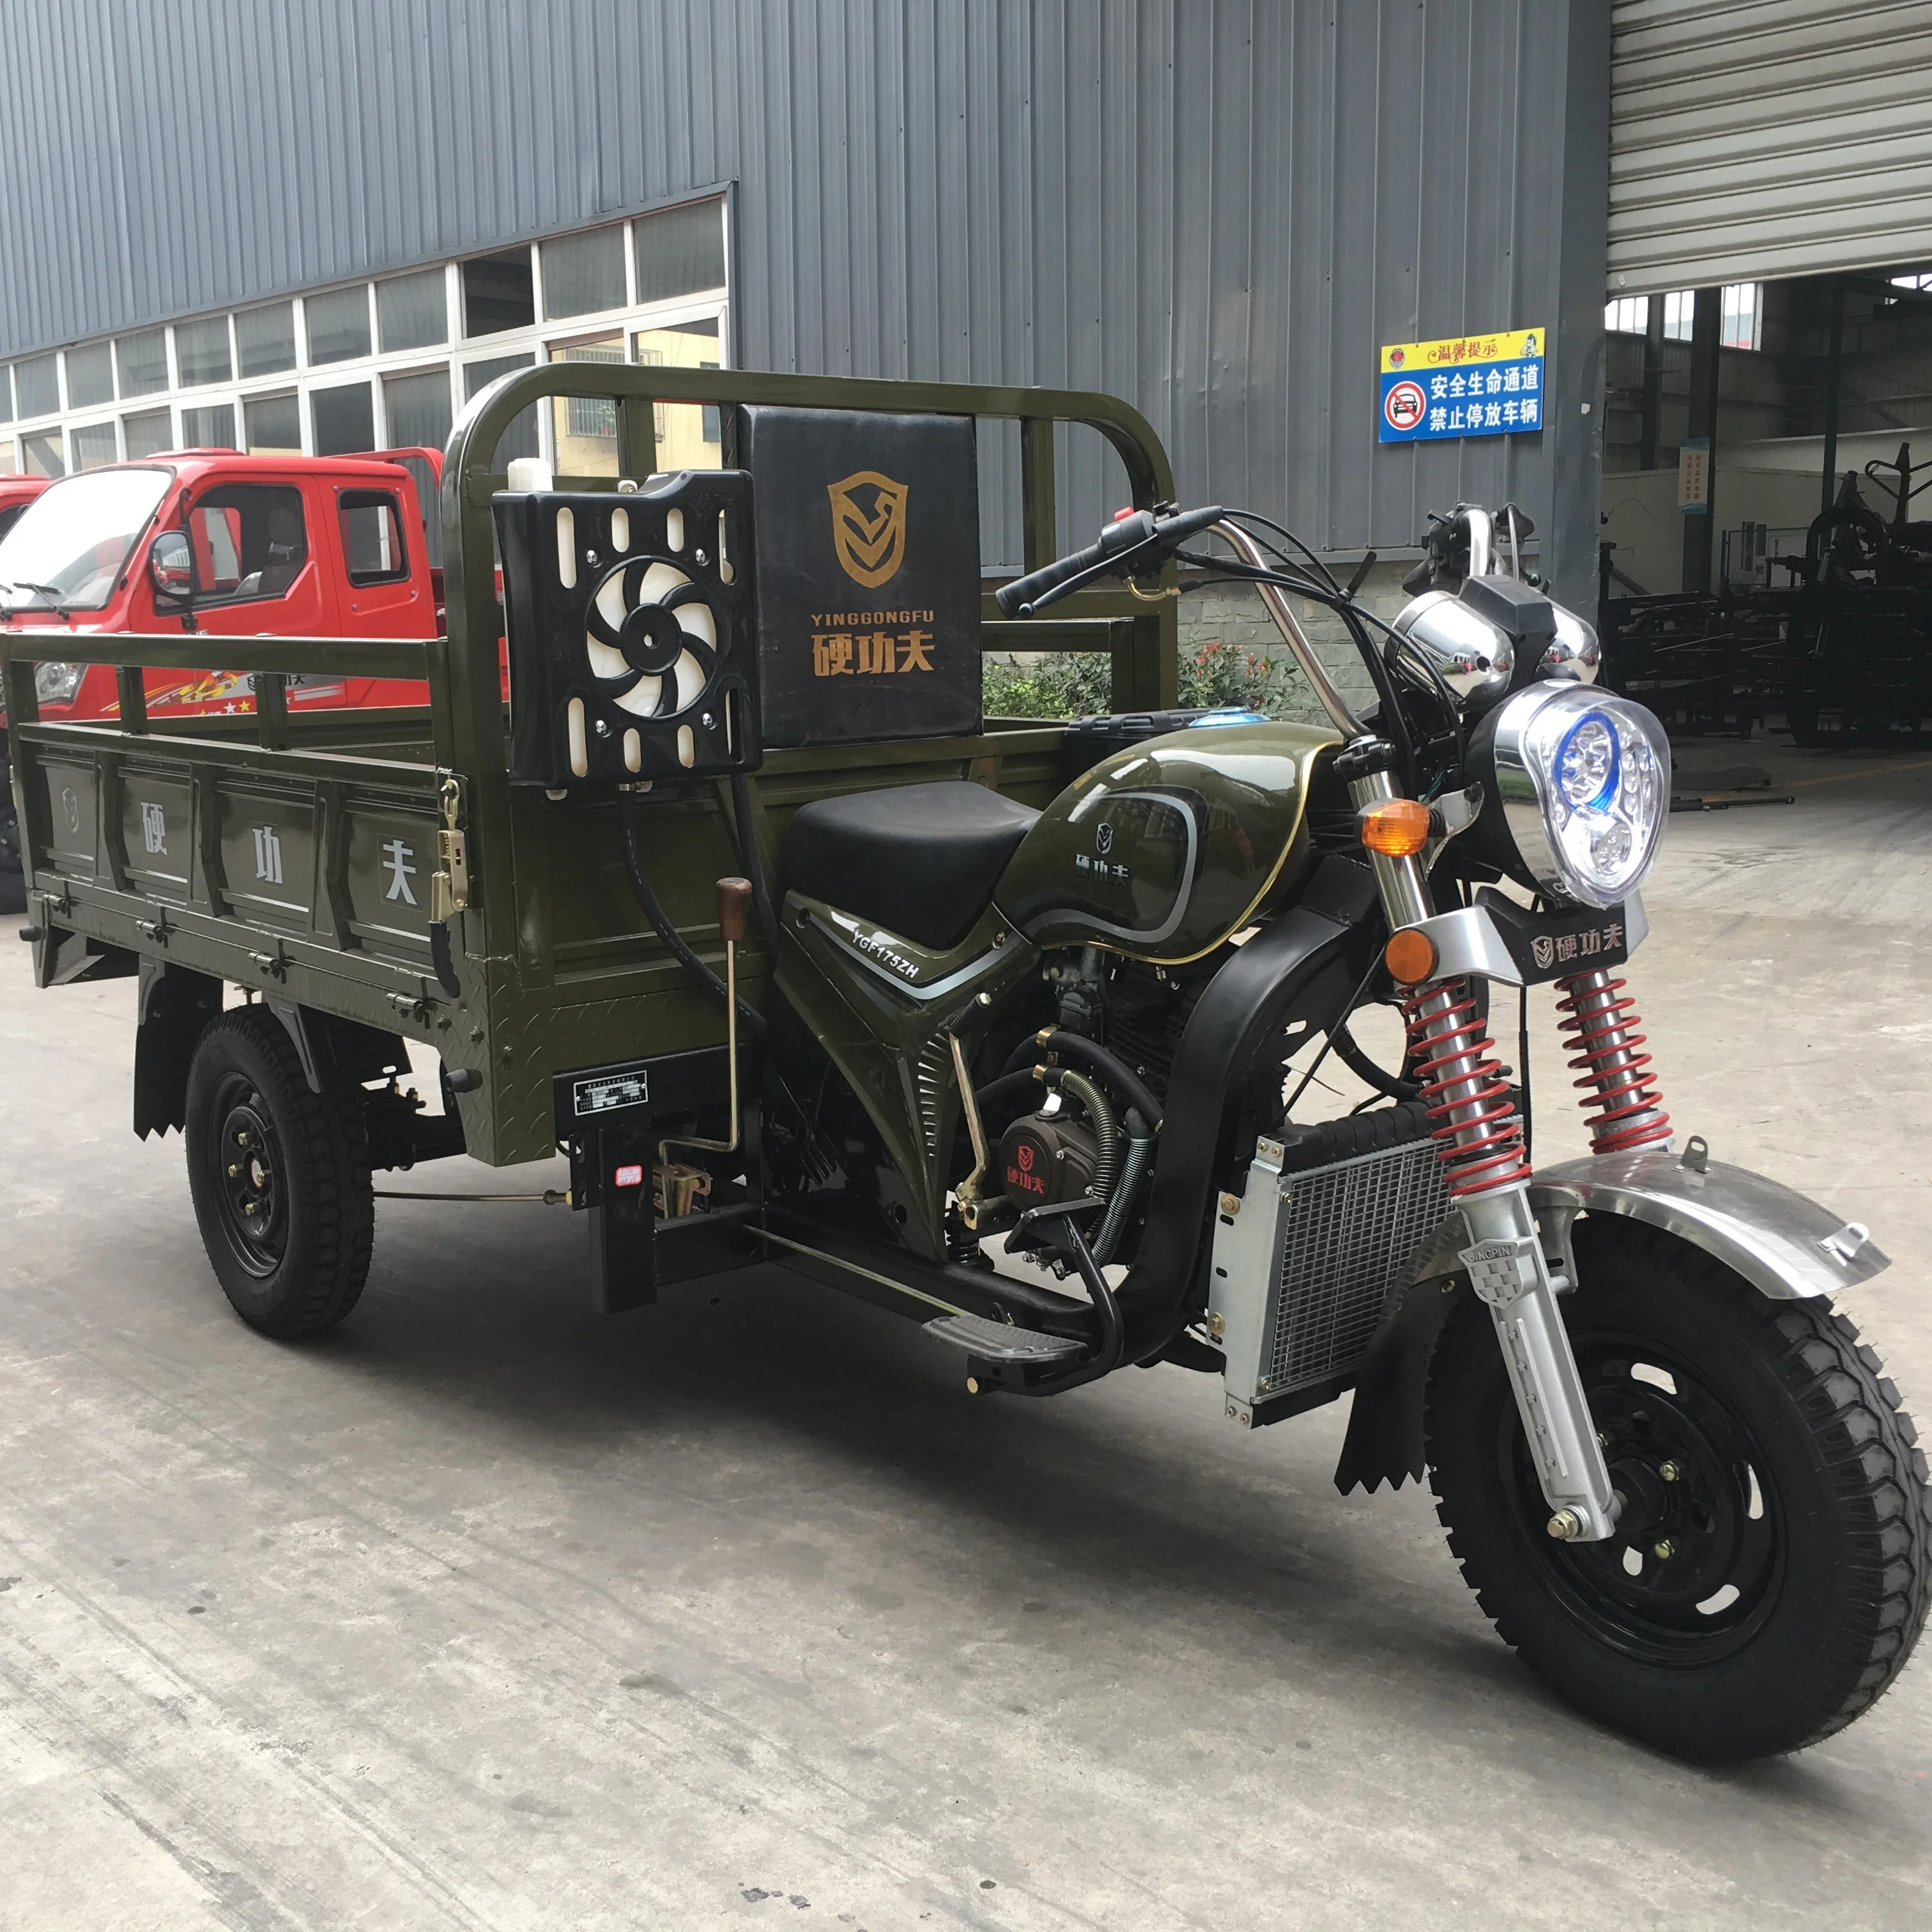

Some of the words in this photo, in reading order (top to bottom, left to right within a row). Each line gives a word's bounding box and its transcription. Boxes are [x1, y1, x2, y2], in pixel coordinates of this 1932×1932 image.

[1428, 339, 1498, 364] 温馨提示
[1430, 364, 1539, 399] 安全生命通道
[1430, 398, 1538, 431] 禁止停放车辆
[811, 610, 935, 627] YINGGONGFU
[811, 630, 935, 677] 硬功夫
[140, 802, 167, 855] 硬
[252, 826, 283, 884] 功
[383, 839, 418, 905] 夫
[852, 930, 920, 979] YGF175ZH
[1554, 923, 1623, 962] 硬功夫
[1007, 1166, 1045, 1194] 硬功夫
[1469, 1246, 1510, 1262] JINGPIN
